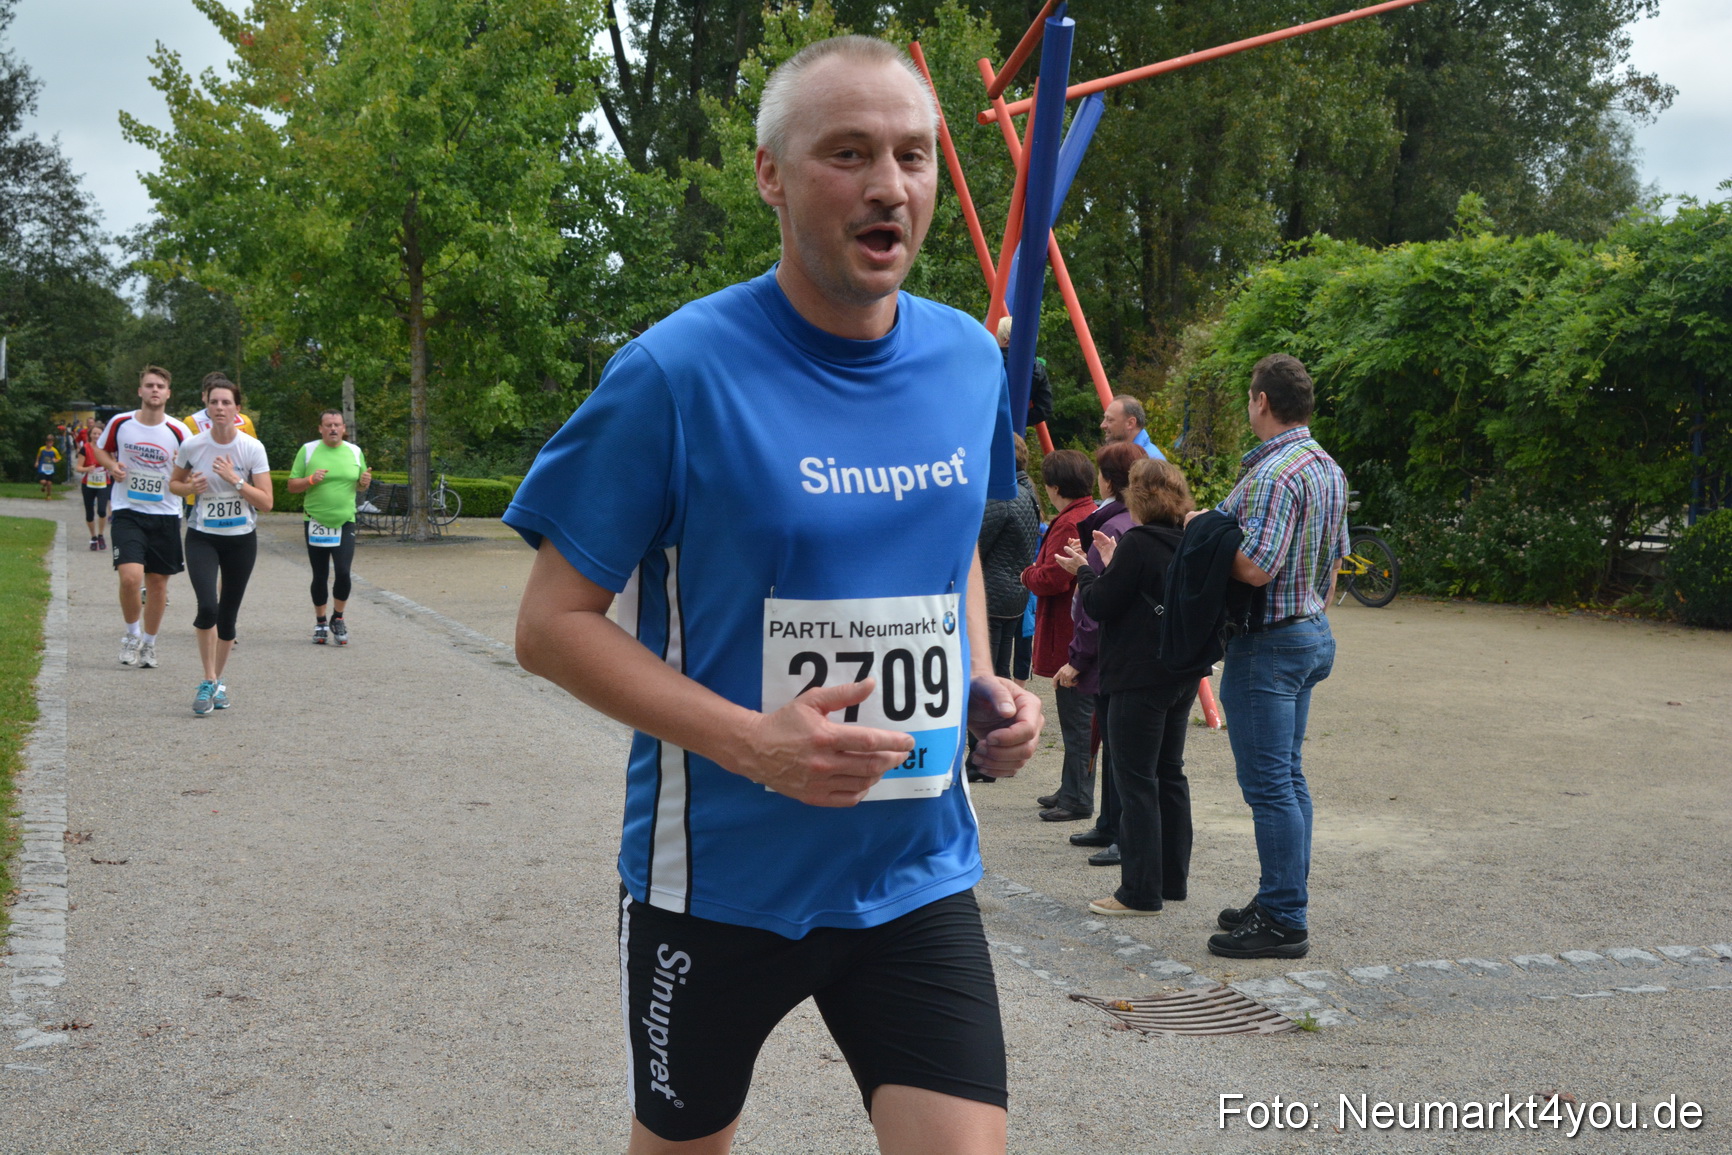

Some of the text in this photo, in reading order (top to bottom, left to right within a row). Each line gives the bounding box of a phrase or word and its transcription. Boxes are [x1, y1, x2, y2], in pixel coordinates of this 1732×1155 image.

[124, 443, 161, 455] GERHART
[130, 477, 162, 493] 3359
[207, 500, 242, 517] 2878
[769, 617, 937, 639] PARTL Neumarkt
[788, 645, 950, 723] 2709
